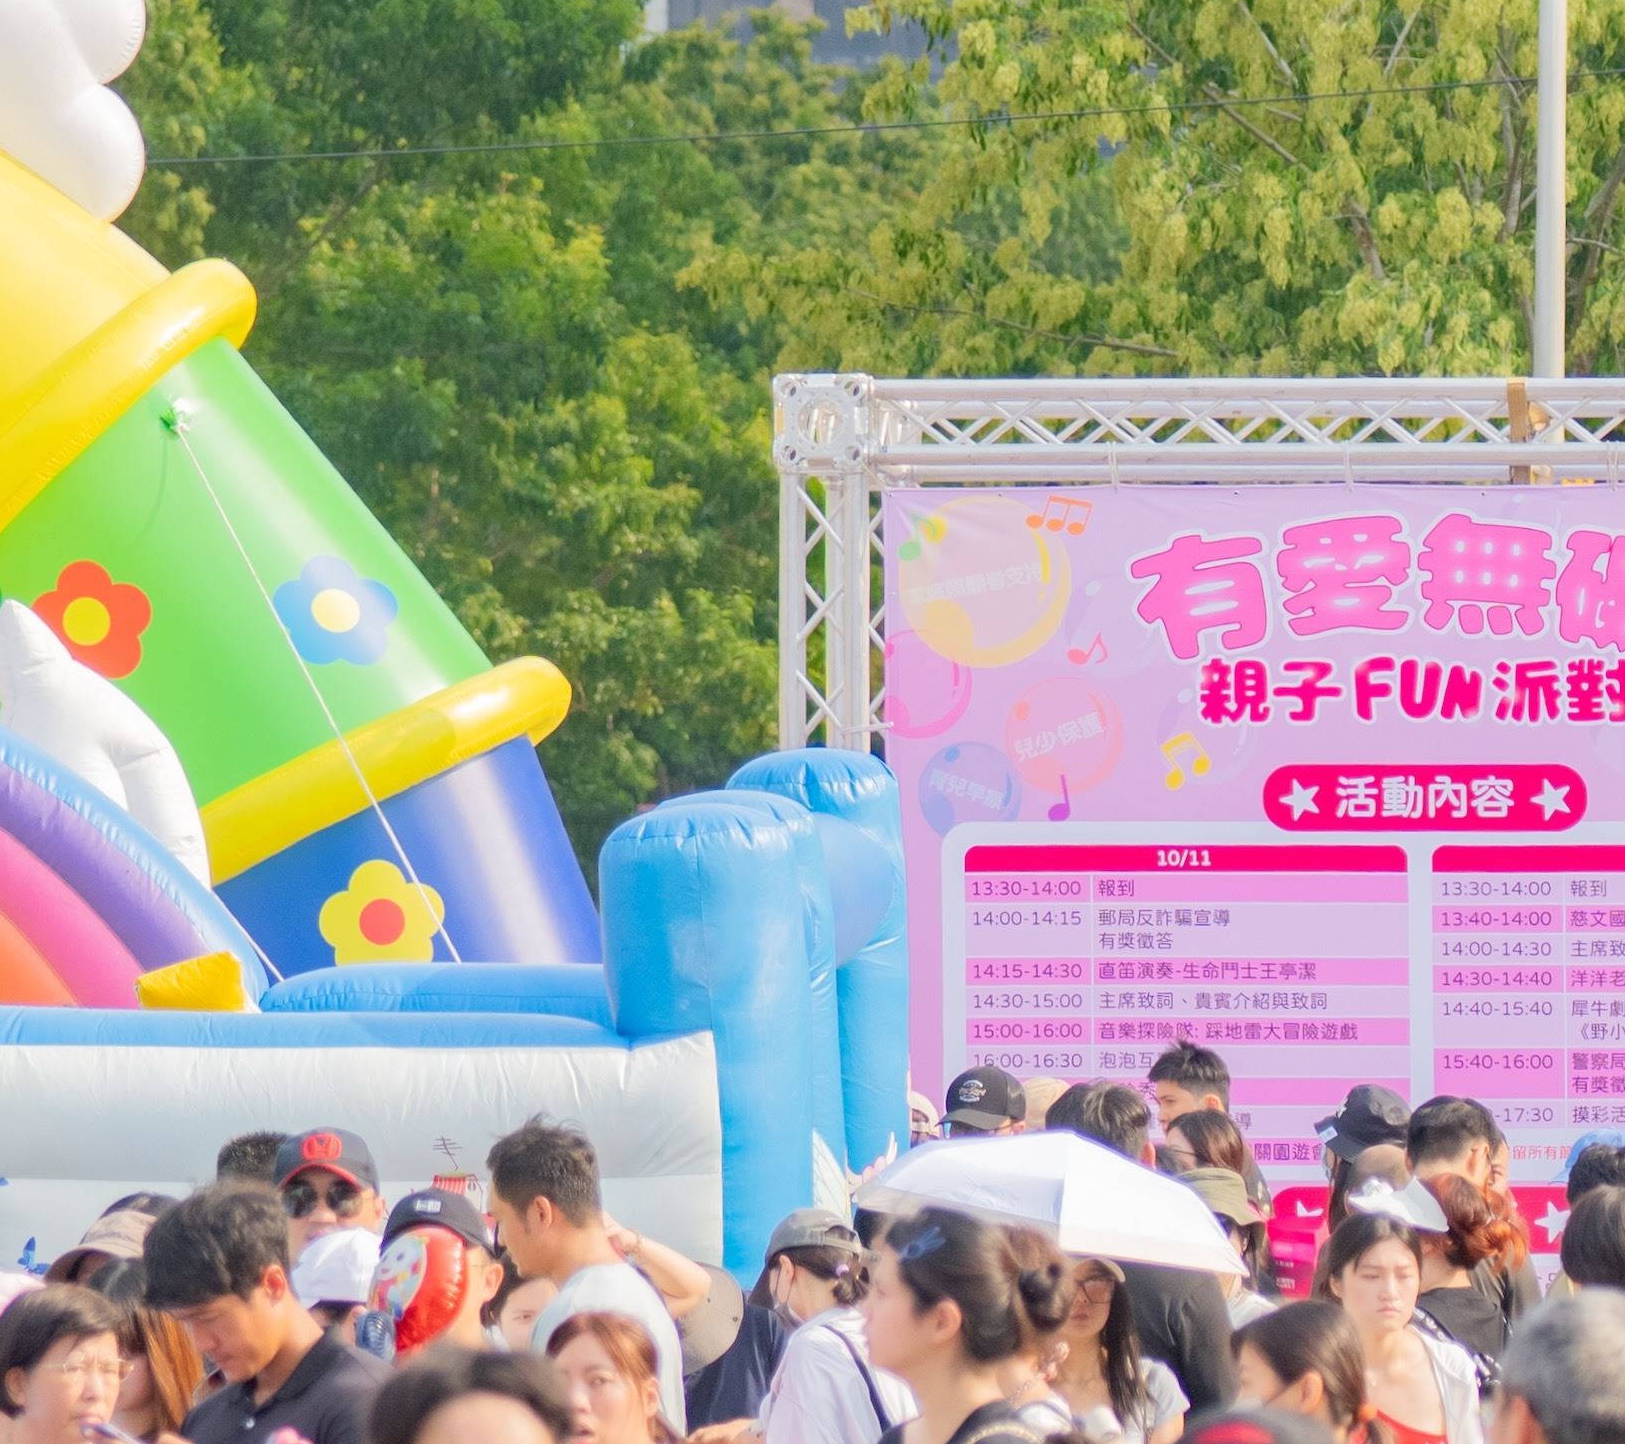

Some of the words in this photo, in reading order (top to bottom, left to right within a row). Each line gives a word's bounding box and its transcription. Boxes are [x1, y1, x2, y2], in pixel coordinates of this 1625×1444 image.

[1336, 775, 1515, 819] 活動內容
[1157, 850, 1211, 867] 10/11
[972, 880, 1082, 896] 13:30-14:00
[1098, 879, 1135, 898] 報到
[1441, 881, 1552, 897] 13:30-14:00
[1570, 879, 1607, 898] 報到
[973, 910, 1082, 926] 14:00-14:15
[1098, 908, 1231, 927] 郵局反詐騙宣導
[1441, 911, 1552, 927] 13:40-14:00
[1098, 931, 1174, 950] 有獎徵答
[1442, 941, 1552, 957] 14:00-14:30
[973, 963, 1083, 979] 14:15-14:30
[1442, 971, 1552, 987] 14:30-14:40
[973, 993, 1083, 1009] 14:30-15:00
[1443, 1001, 1553, 1016] 14:40-15:40
[973, 1023, 1083, 1039] 15:00-16:00
[972, 1054, 1083, 1069] 16:00-16:30
[1443, 1054, 1554, 1070] 15:40-16:00
